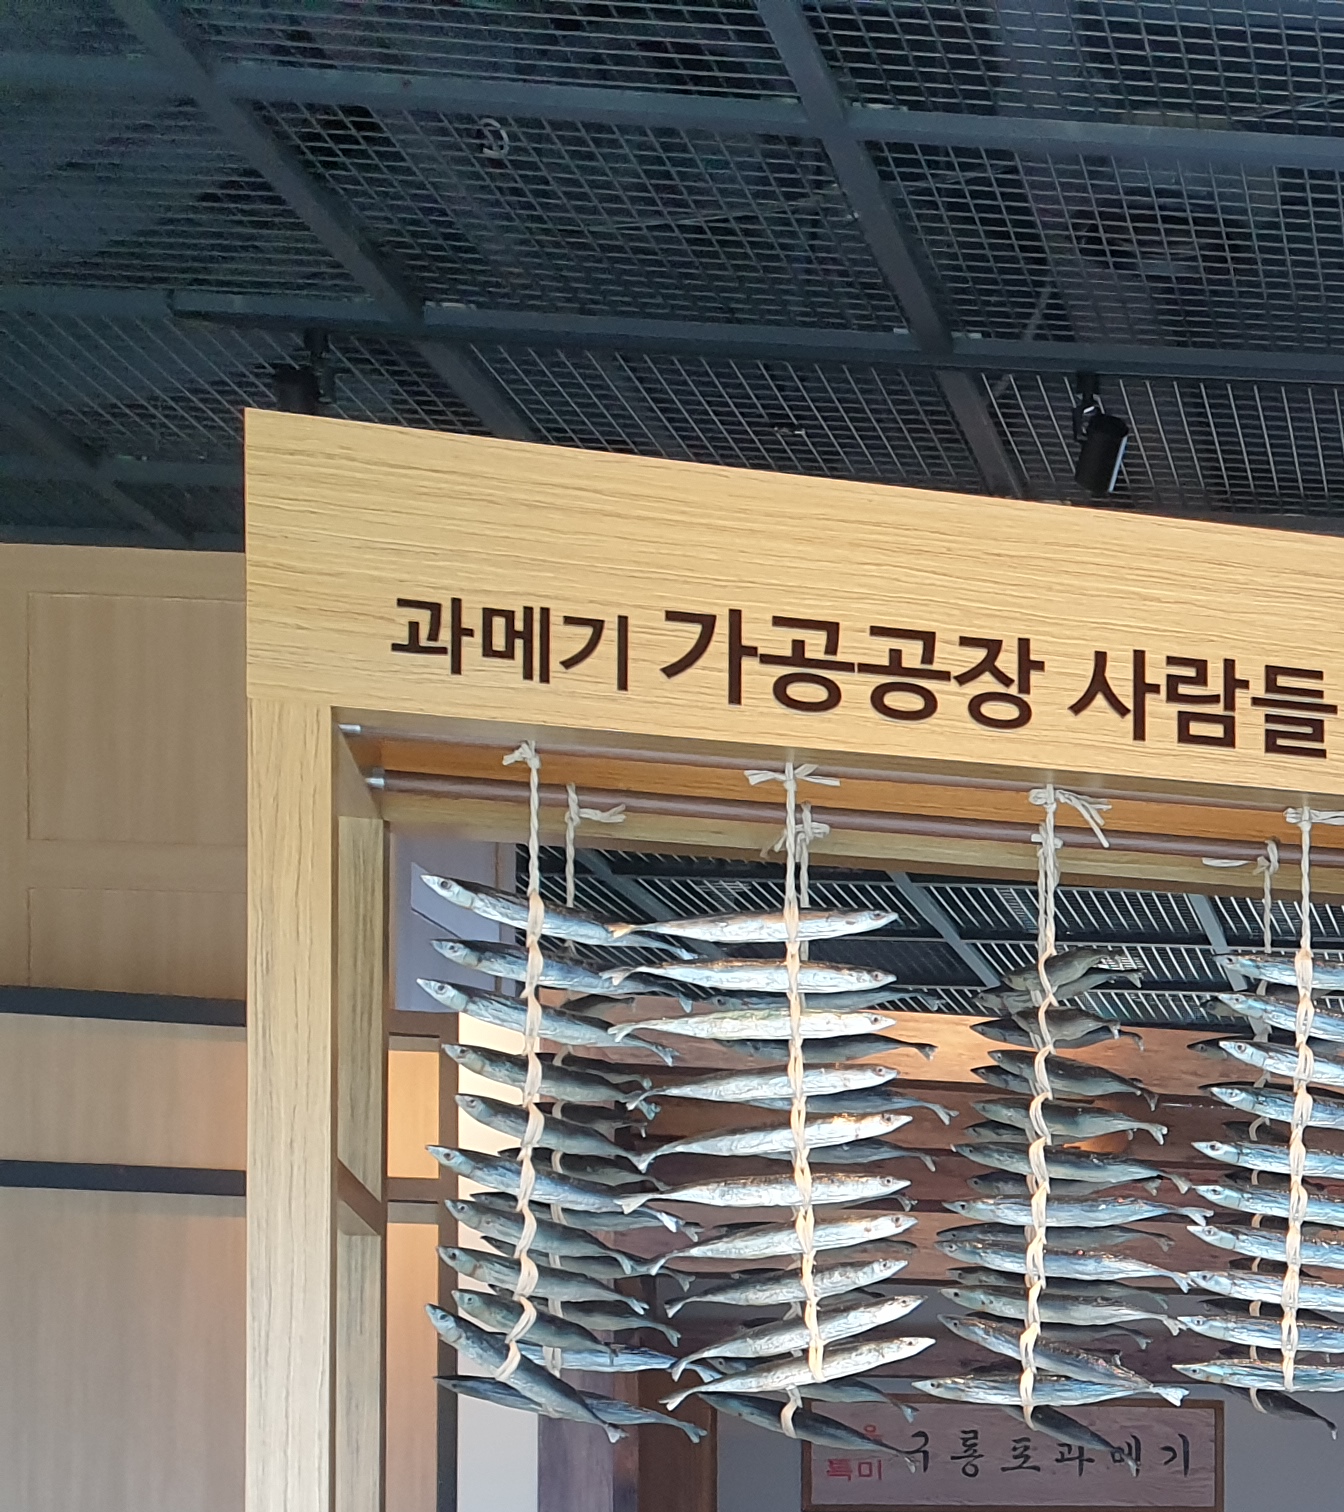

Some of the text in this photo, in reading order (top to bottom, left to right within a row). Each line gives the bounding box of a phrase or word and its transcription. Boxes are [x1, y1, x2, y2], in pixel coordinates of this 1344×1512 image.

[392, 598, 1337, 758] 과메기 가공공장 사람들
